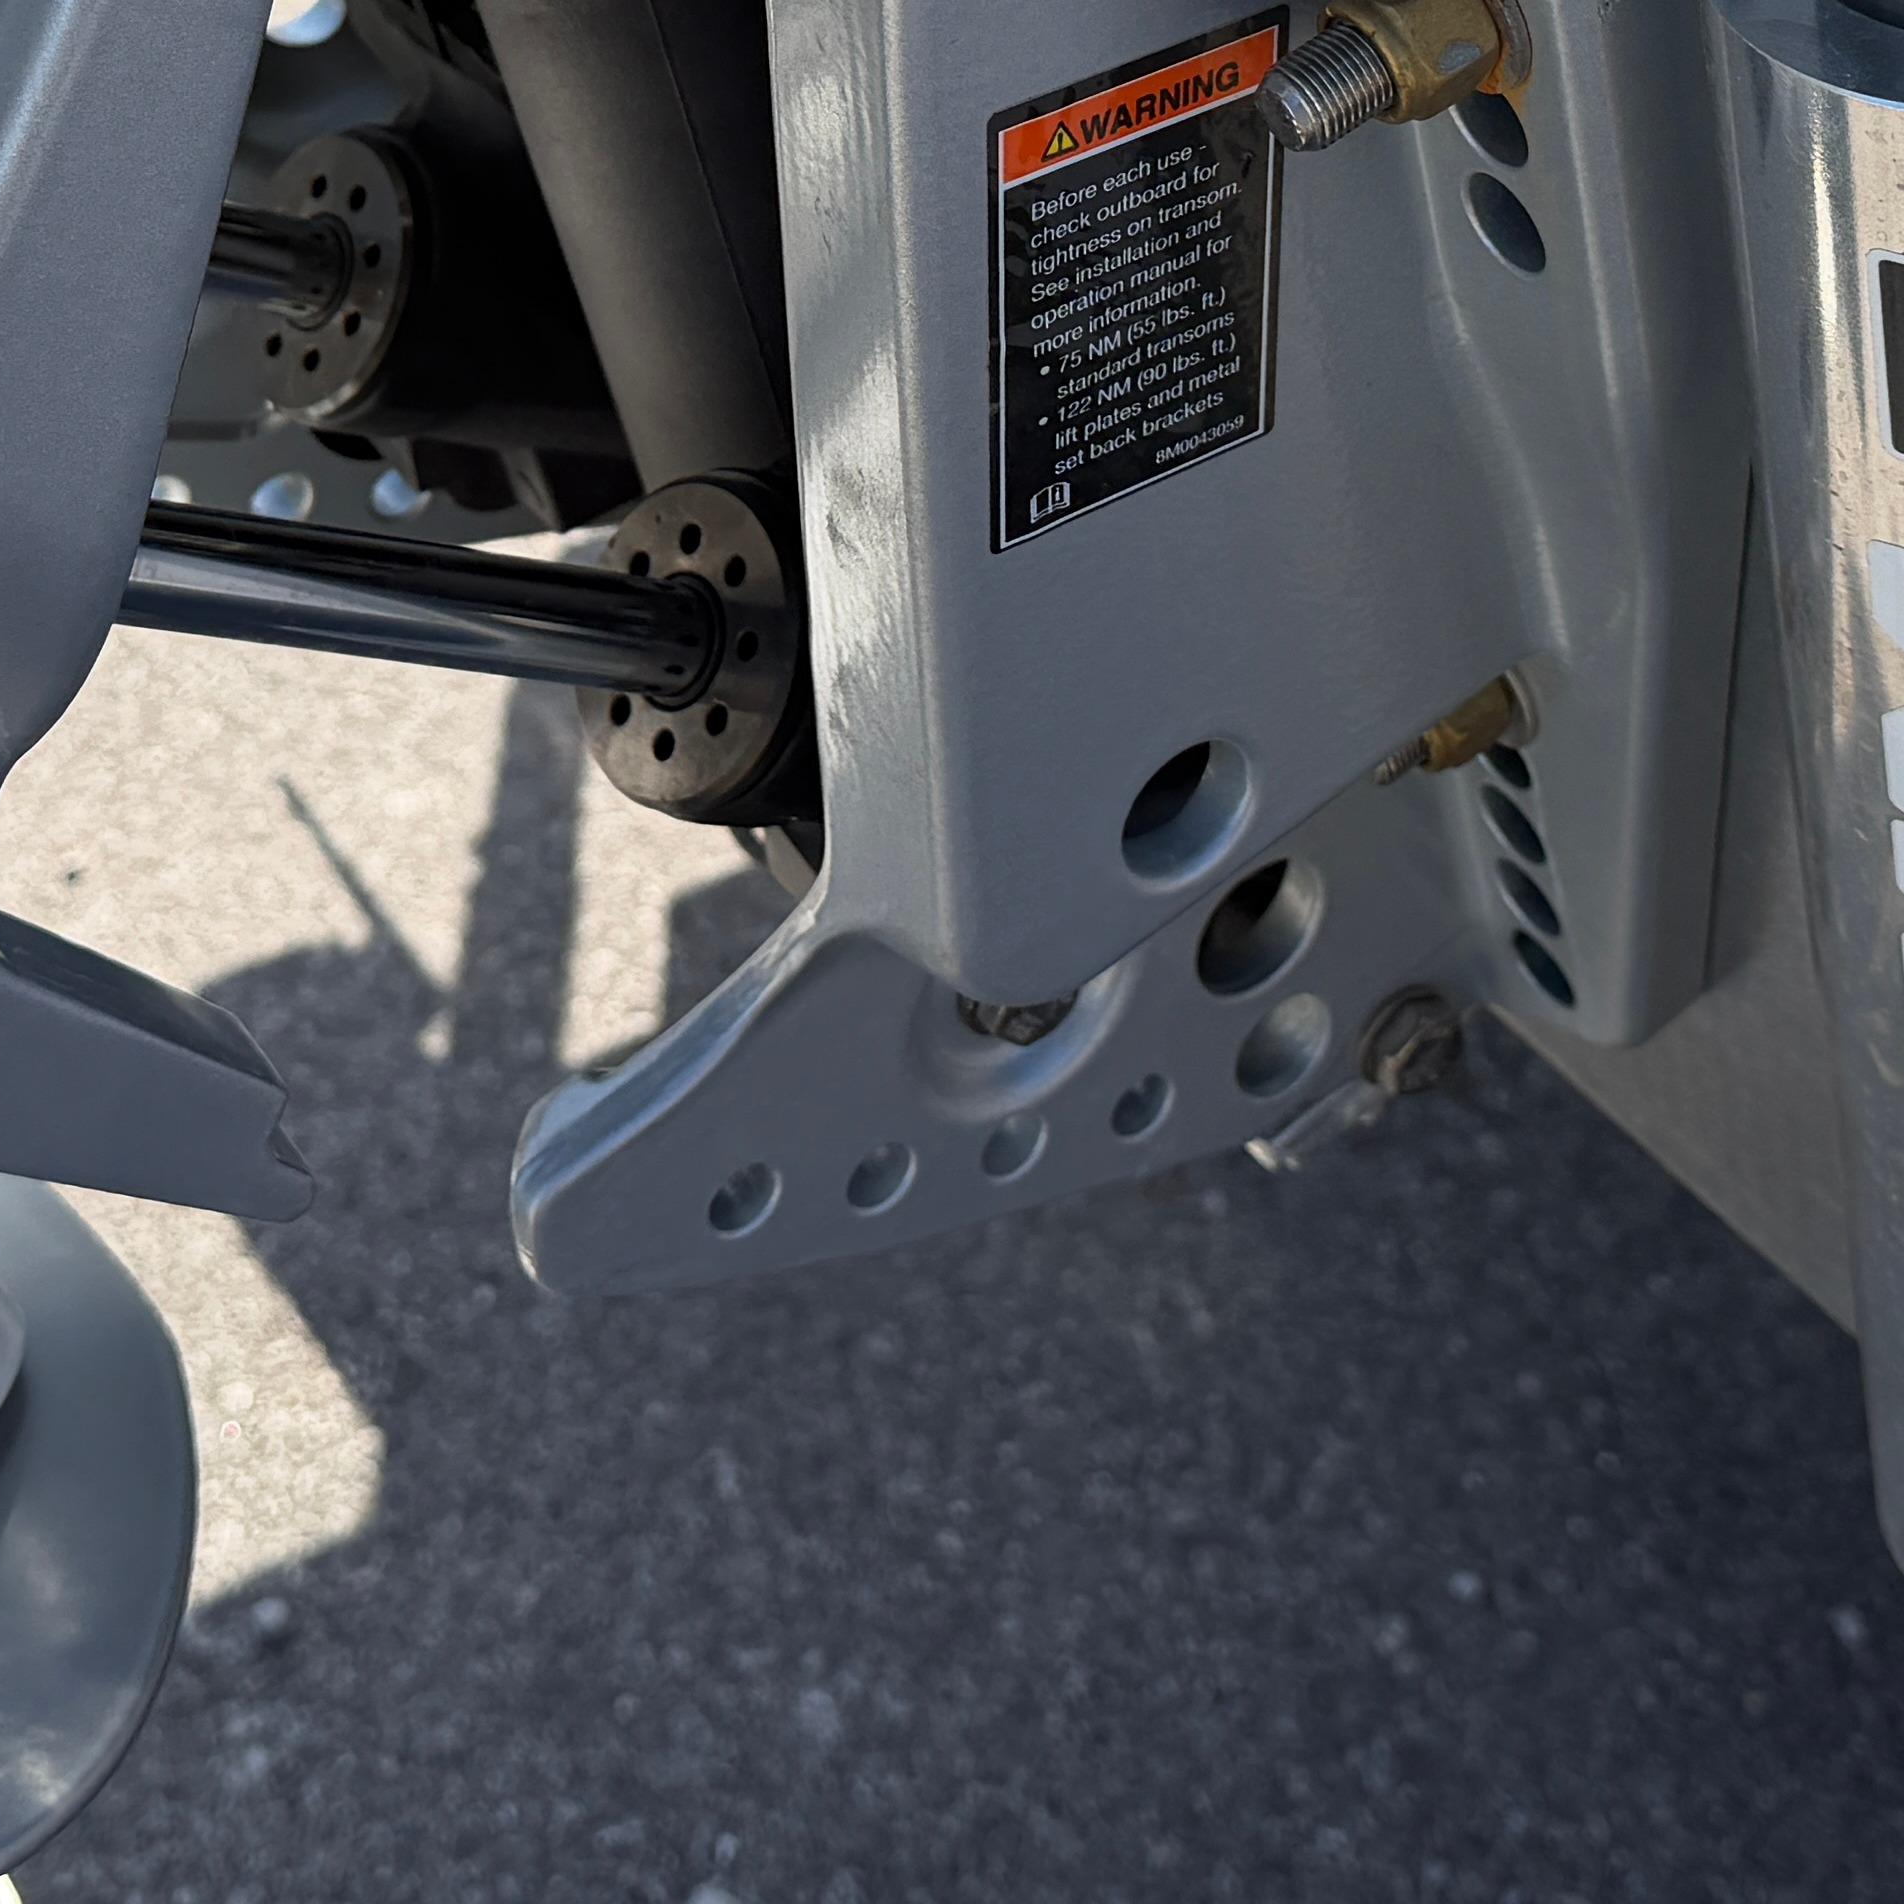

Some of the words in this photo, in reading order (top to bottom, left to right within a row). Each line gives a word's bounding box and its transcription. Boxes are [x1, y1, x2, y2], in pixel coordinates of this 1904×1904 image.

[1080, 62, 1239, 145] WARNING
[1031, 183, 1097, 222] Before
[1103, 161, 1150, 192] each
[1157, 146, 1192, 171] use
[1031, 211, 1091, 249] check
[1097, 176, 1186, 222] outboard
[1193, 162, 1220, 184] for
[1031, 229, 1121, 279] tightness
[1127, 217, 1151, 237] on
[1159, 183, 1242, 224] transom.
[1031, 277, 1069, 303] See
[1075, 230, 1179, 286] installation
[1185, 211, 1222, 239] and
[1031, 280, 1124, 330] operation
[1130, 245, 1200, 288] manual
[1206, 234, 1233, 257] for
[1033, 325, 1083, 357] more
[1089, 276, 1201, 333] information.
[1057, 347, 1141, 399] standard
[1147, 311, 1235, 358] transoms
[1059, 350, 1082, 373] 75
[1089, 330, 1121, 360] NM
[1127, 318, 1156, 345] (55
[1162, 305, 1195, 328] lbs.
[1202, 286, 1226, 309] ft.)
[1055, 427, 1078, 450] lift
[1084, 399, 1142, 441] plates
[1147, 380, 1183, 409] and
[1189, 356, 1241, 391] metal
[1057, 396, 1091, 422] 122
[1098, 376, 1131, 405] NM
[1137, 363, 1167, 391] (90
[1173, 352, 1205, 373] lbs.
[1212, 333, 1237, 356] ft.)
[1055, 450, 1084, 475] set
[1090, 428, 1137, 460] back
[1143, 390, 1224, 437] brackets
[1155, 415, 1245, 464] 8M0043059
